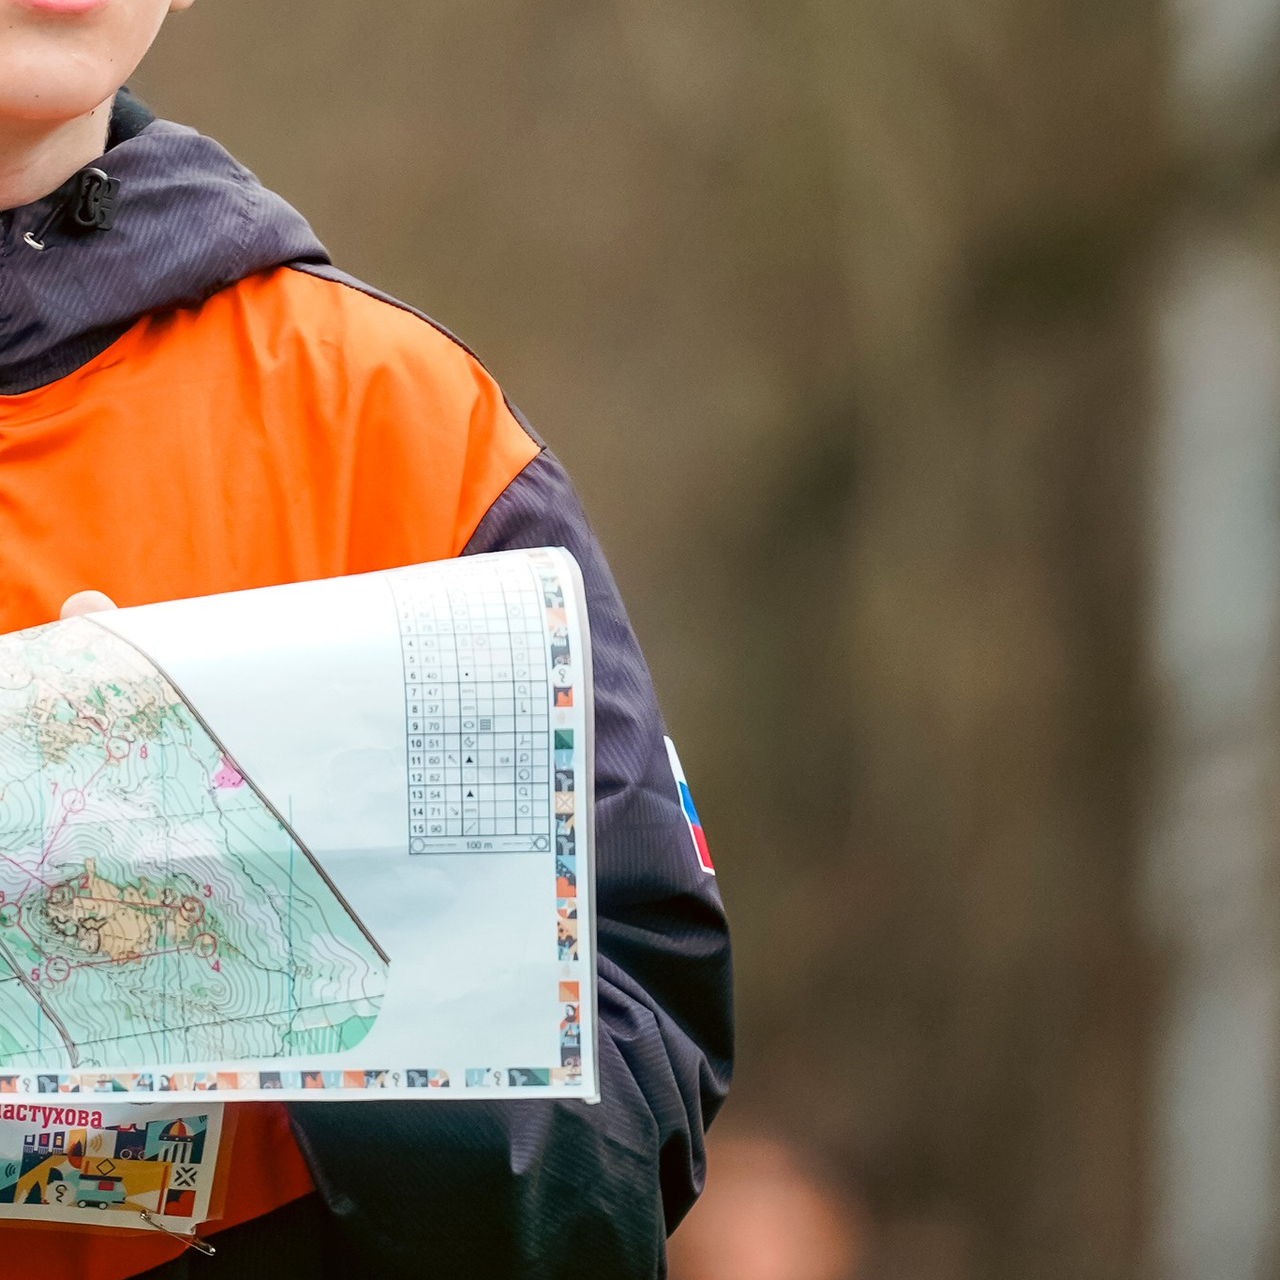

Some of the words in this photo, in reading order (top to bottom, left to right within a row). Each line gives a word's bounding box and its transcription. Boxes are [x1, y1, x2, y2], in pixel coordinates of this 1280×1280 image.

[427, 688, 438, 696] 47
[412, 722, 418, 730] 9
[429, 722, 440, 730] 70
[411, 739, 422, 748] 10
[429, 739, 439, 748] 51
[139, 745, 148, 759] 8
[411, 756, 421, 764] 11
[412, 773, 422, 782] 12
[51, 782, 59, 795] 7
[412, 791, 423, 799] 13
[430, 791, 441, 799] 54
[413, 807, 423, 816] 14
[430, 807, 441, 816] 71
[413, 824, 424, 833] 15
[466, 841, 481, 850] 100
[79, 875, 90, 889] 2
[203, 885, 213, 898] 3
[211, 960, 221, 972] 4
[31, 968, 40, 981] 5
